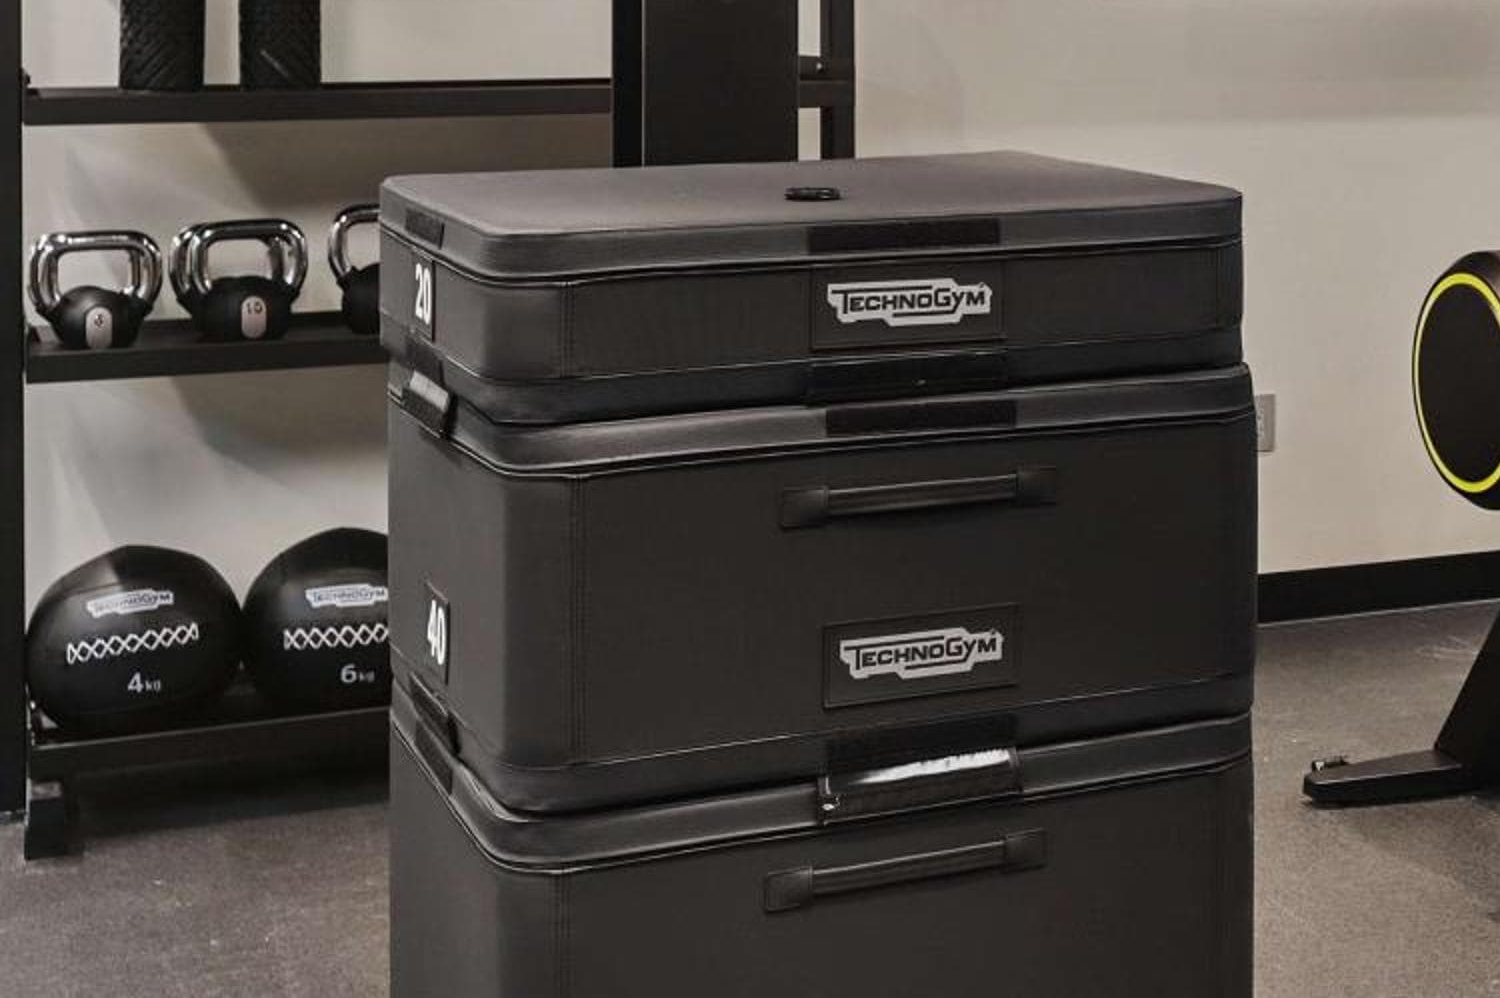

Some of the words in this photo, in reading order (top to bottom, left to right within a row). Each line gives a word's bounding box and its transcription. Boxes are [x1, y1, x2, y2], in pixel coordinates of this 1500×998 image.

[246, 301, 264, 315] 10
[415, 262, 431, 325] 20
[830, 284, 986, 319] TECHNOGYM
[427, 600, 446, 665] 40
[843, 635, 998, 671] TECHNOGYM
